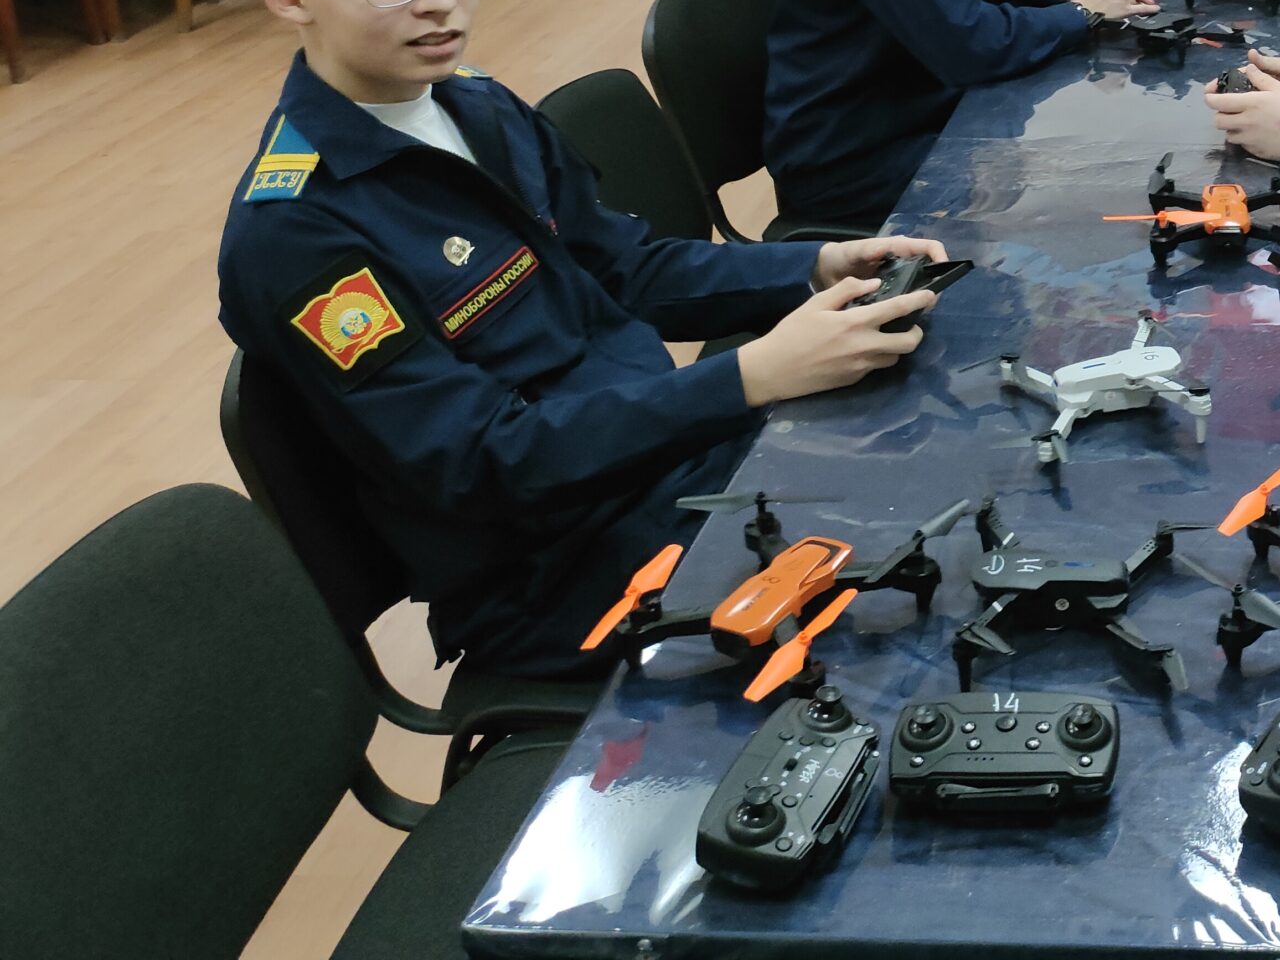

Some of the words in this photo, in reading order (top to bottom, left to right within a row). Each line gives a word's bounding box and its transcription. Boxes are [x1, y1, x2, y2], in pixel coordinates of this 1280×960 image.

[443, 277, 509, 333] МИНОБОРОНЫ
[502, 252, 534, 285] РОССИИ
[991, 691, 1022, 715] 14
